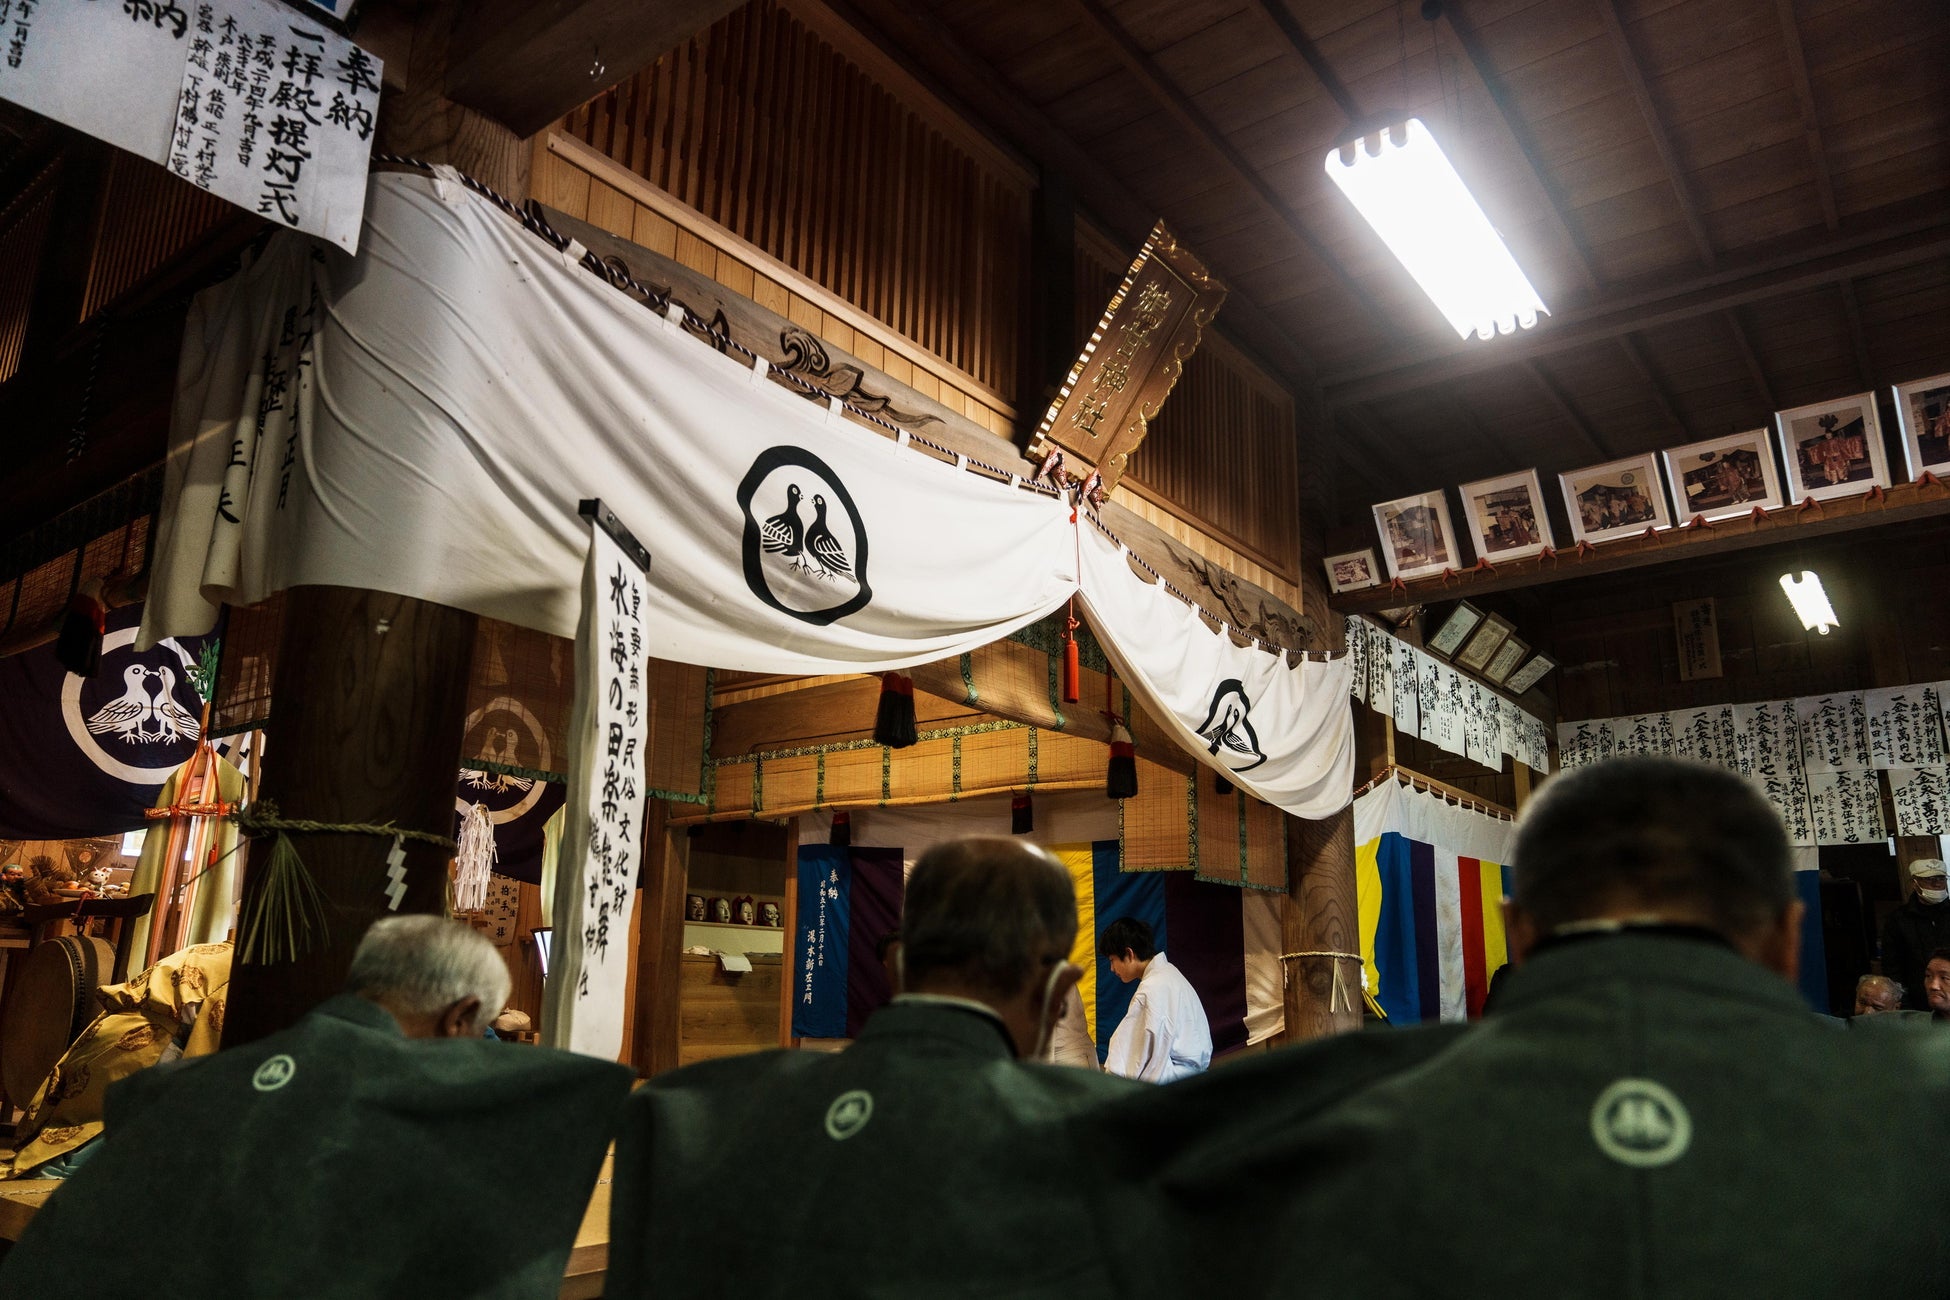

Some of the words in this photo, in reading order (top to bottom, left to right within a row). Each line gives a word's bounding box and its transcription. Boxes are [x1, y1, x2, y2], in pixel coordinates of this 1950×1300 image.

[238, 34, 277, 168] 平成二十四年九月吉日
[325, 48, 379, 141] 奉納
[593, 560, 630, 966] 水海の田楽能舞
[1658, 713, 1674, 755] 永代御
[496, 876, 511, 939] 拍手一拝
[827, 868, 839, 900] 奉納
